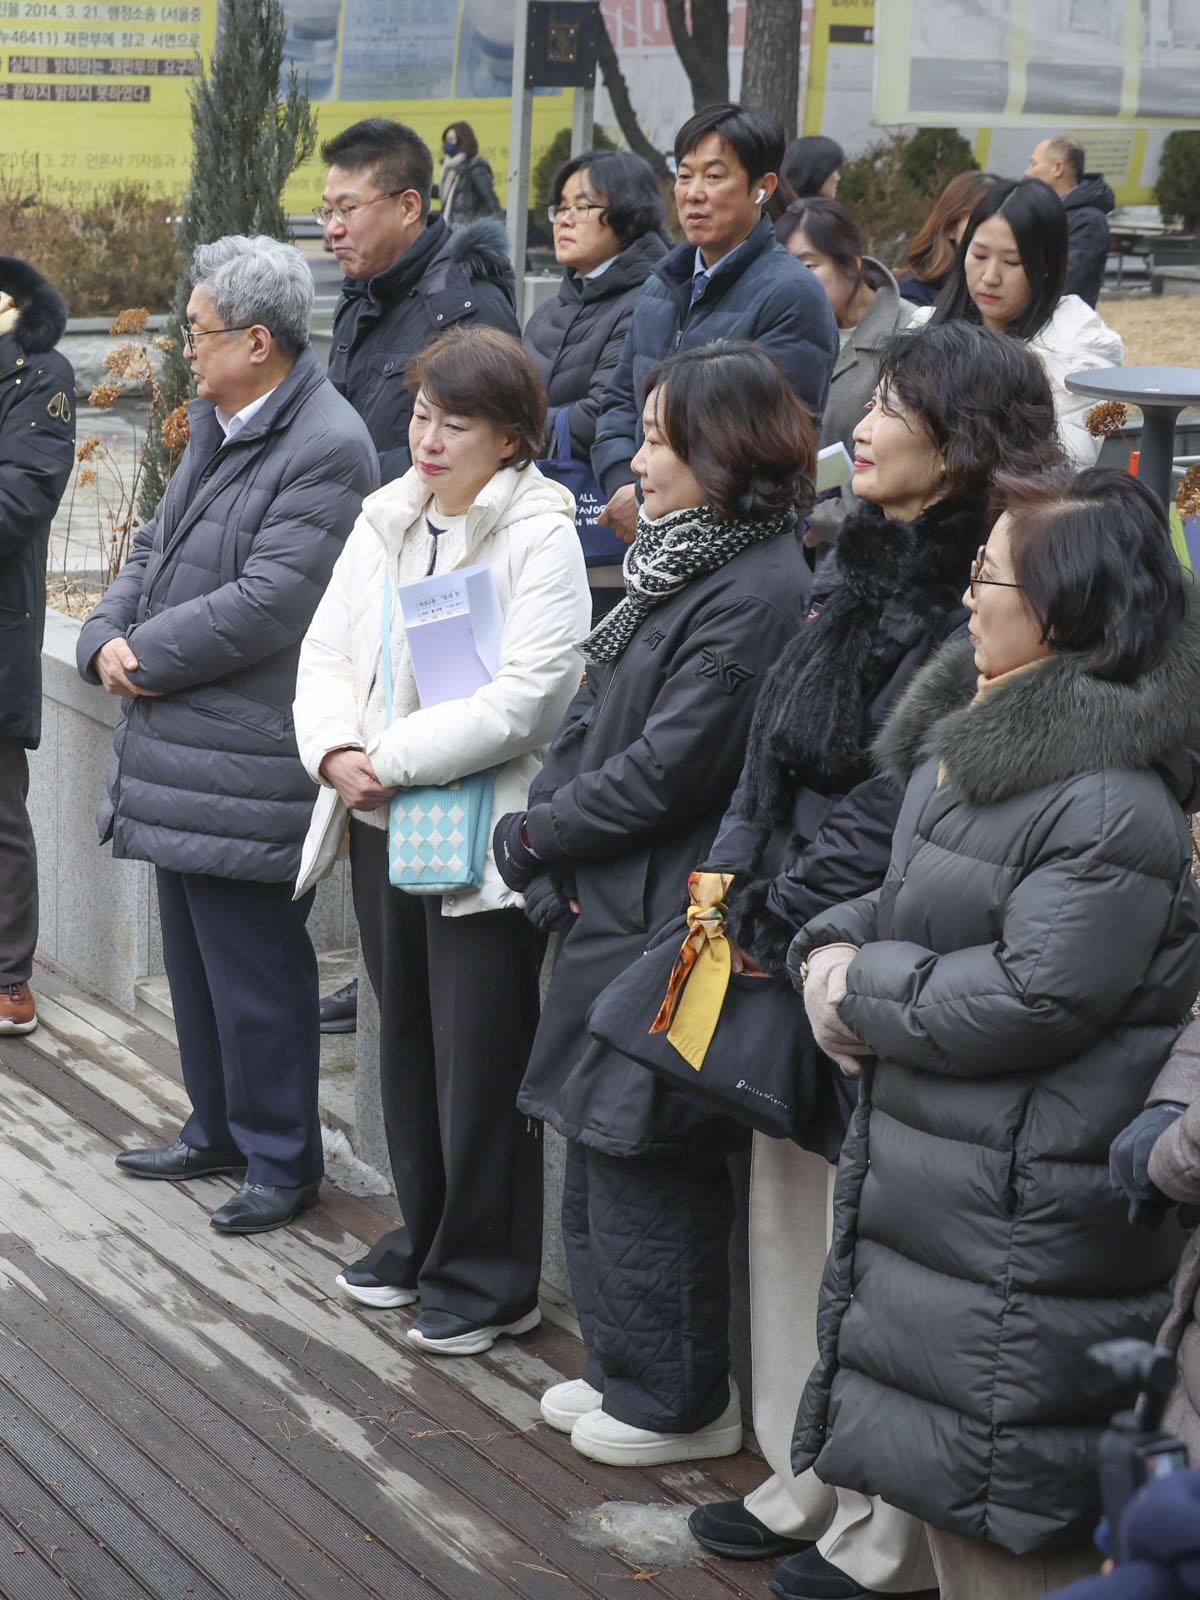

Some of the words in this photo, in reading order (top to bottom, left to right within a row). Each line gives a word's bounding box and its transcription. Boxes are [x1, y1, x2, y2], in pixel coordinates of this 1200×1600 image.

[108, 5, 156, 22] 행정소송
[161, 5, 202, 23] (서울중
[64, 31, 115, 48] 재판부에
[120, 32, 145, 48] 참고
[579, 493, 598, 503] ALL
